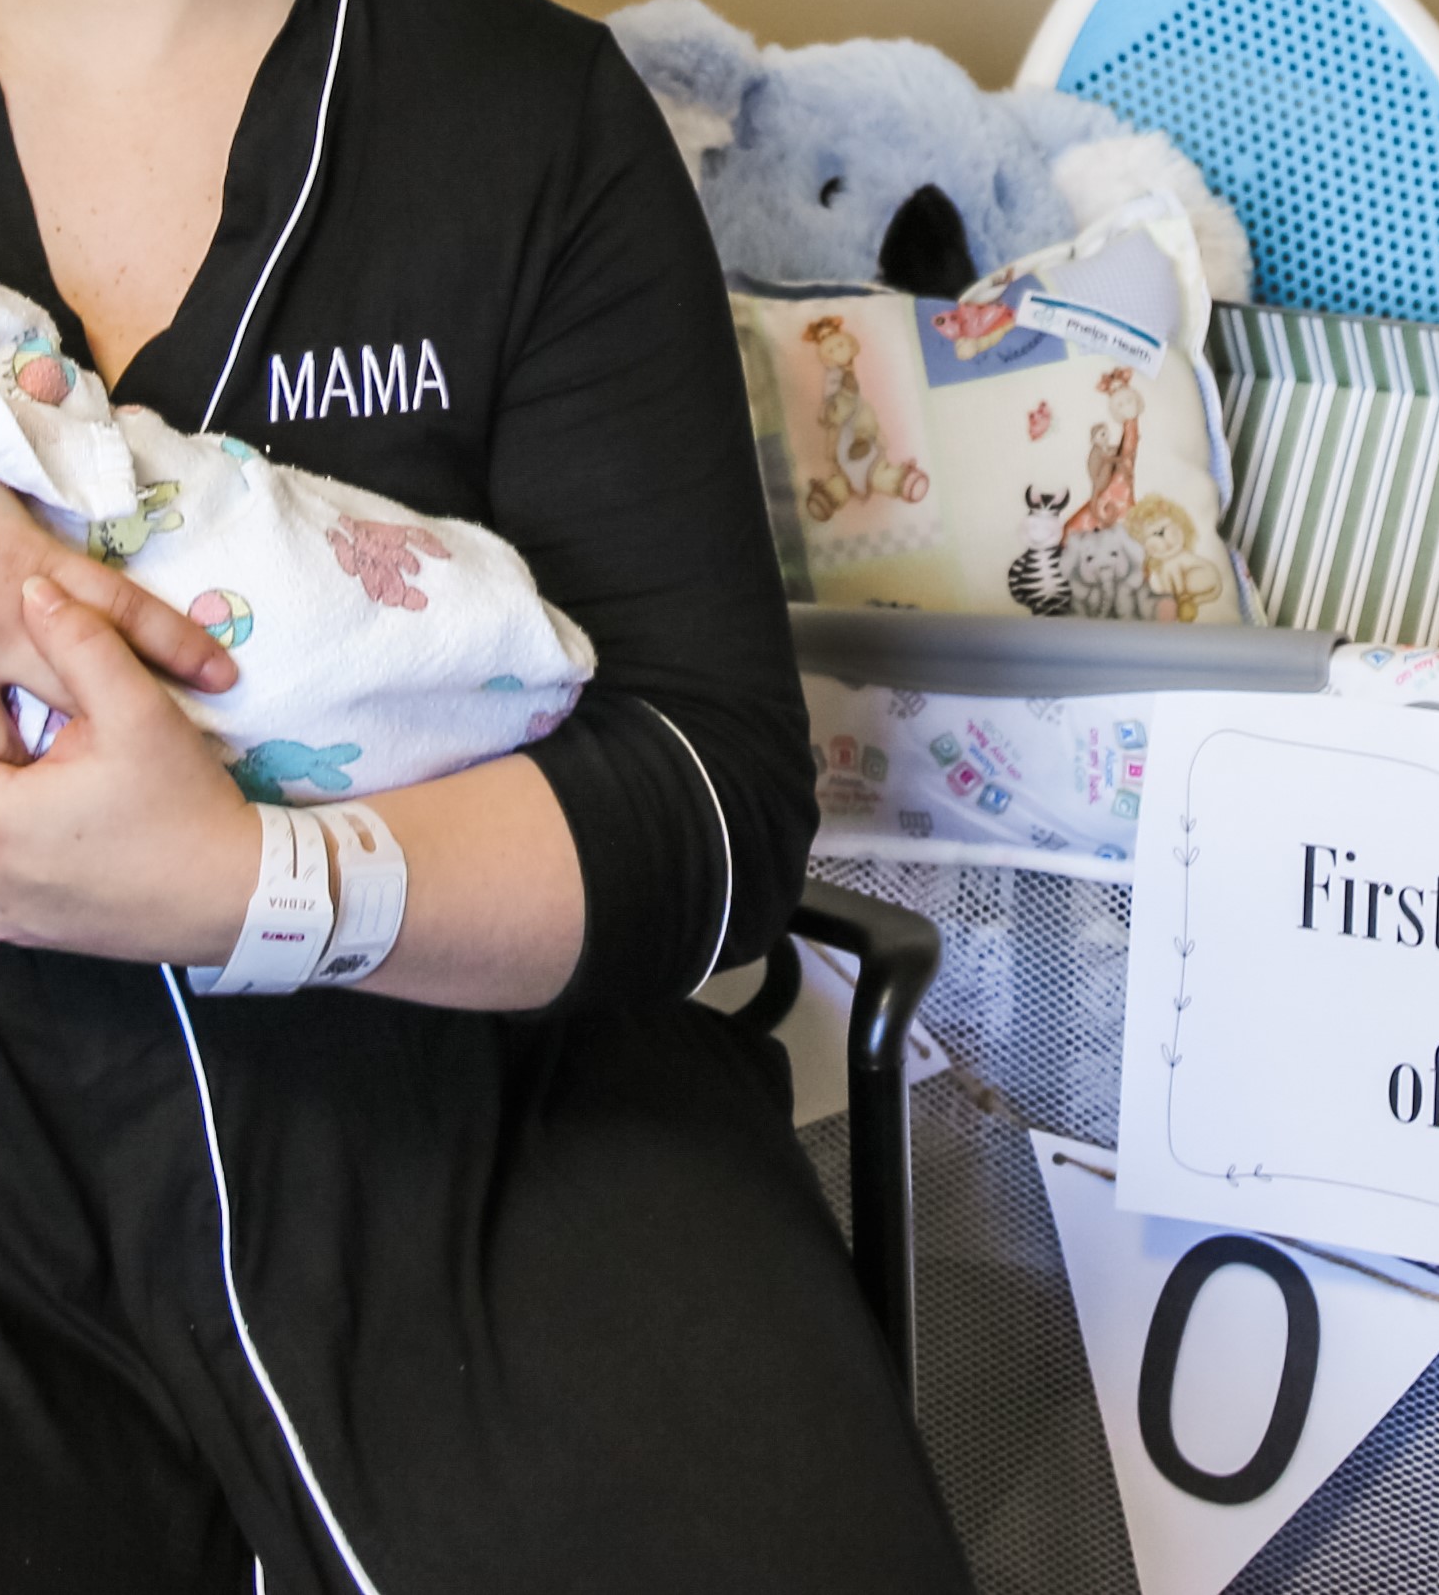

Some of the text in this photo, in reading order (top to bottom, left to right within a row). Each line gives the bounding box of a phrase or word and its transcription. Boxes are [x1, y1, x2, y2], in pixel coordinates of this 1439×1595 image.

[269, 338, 449, 423] MAMA
[1066, 317, 1152, 364] Phelps Health
[1137, 1234, 1320, 1504] 0
